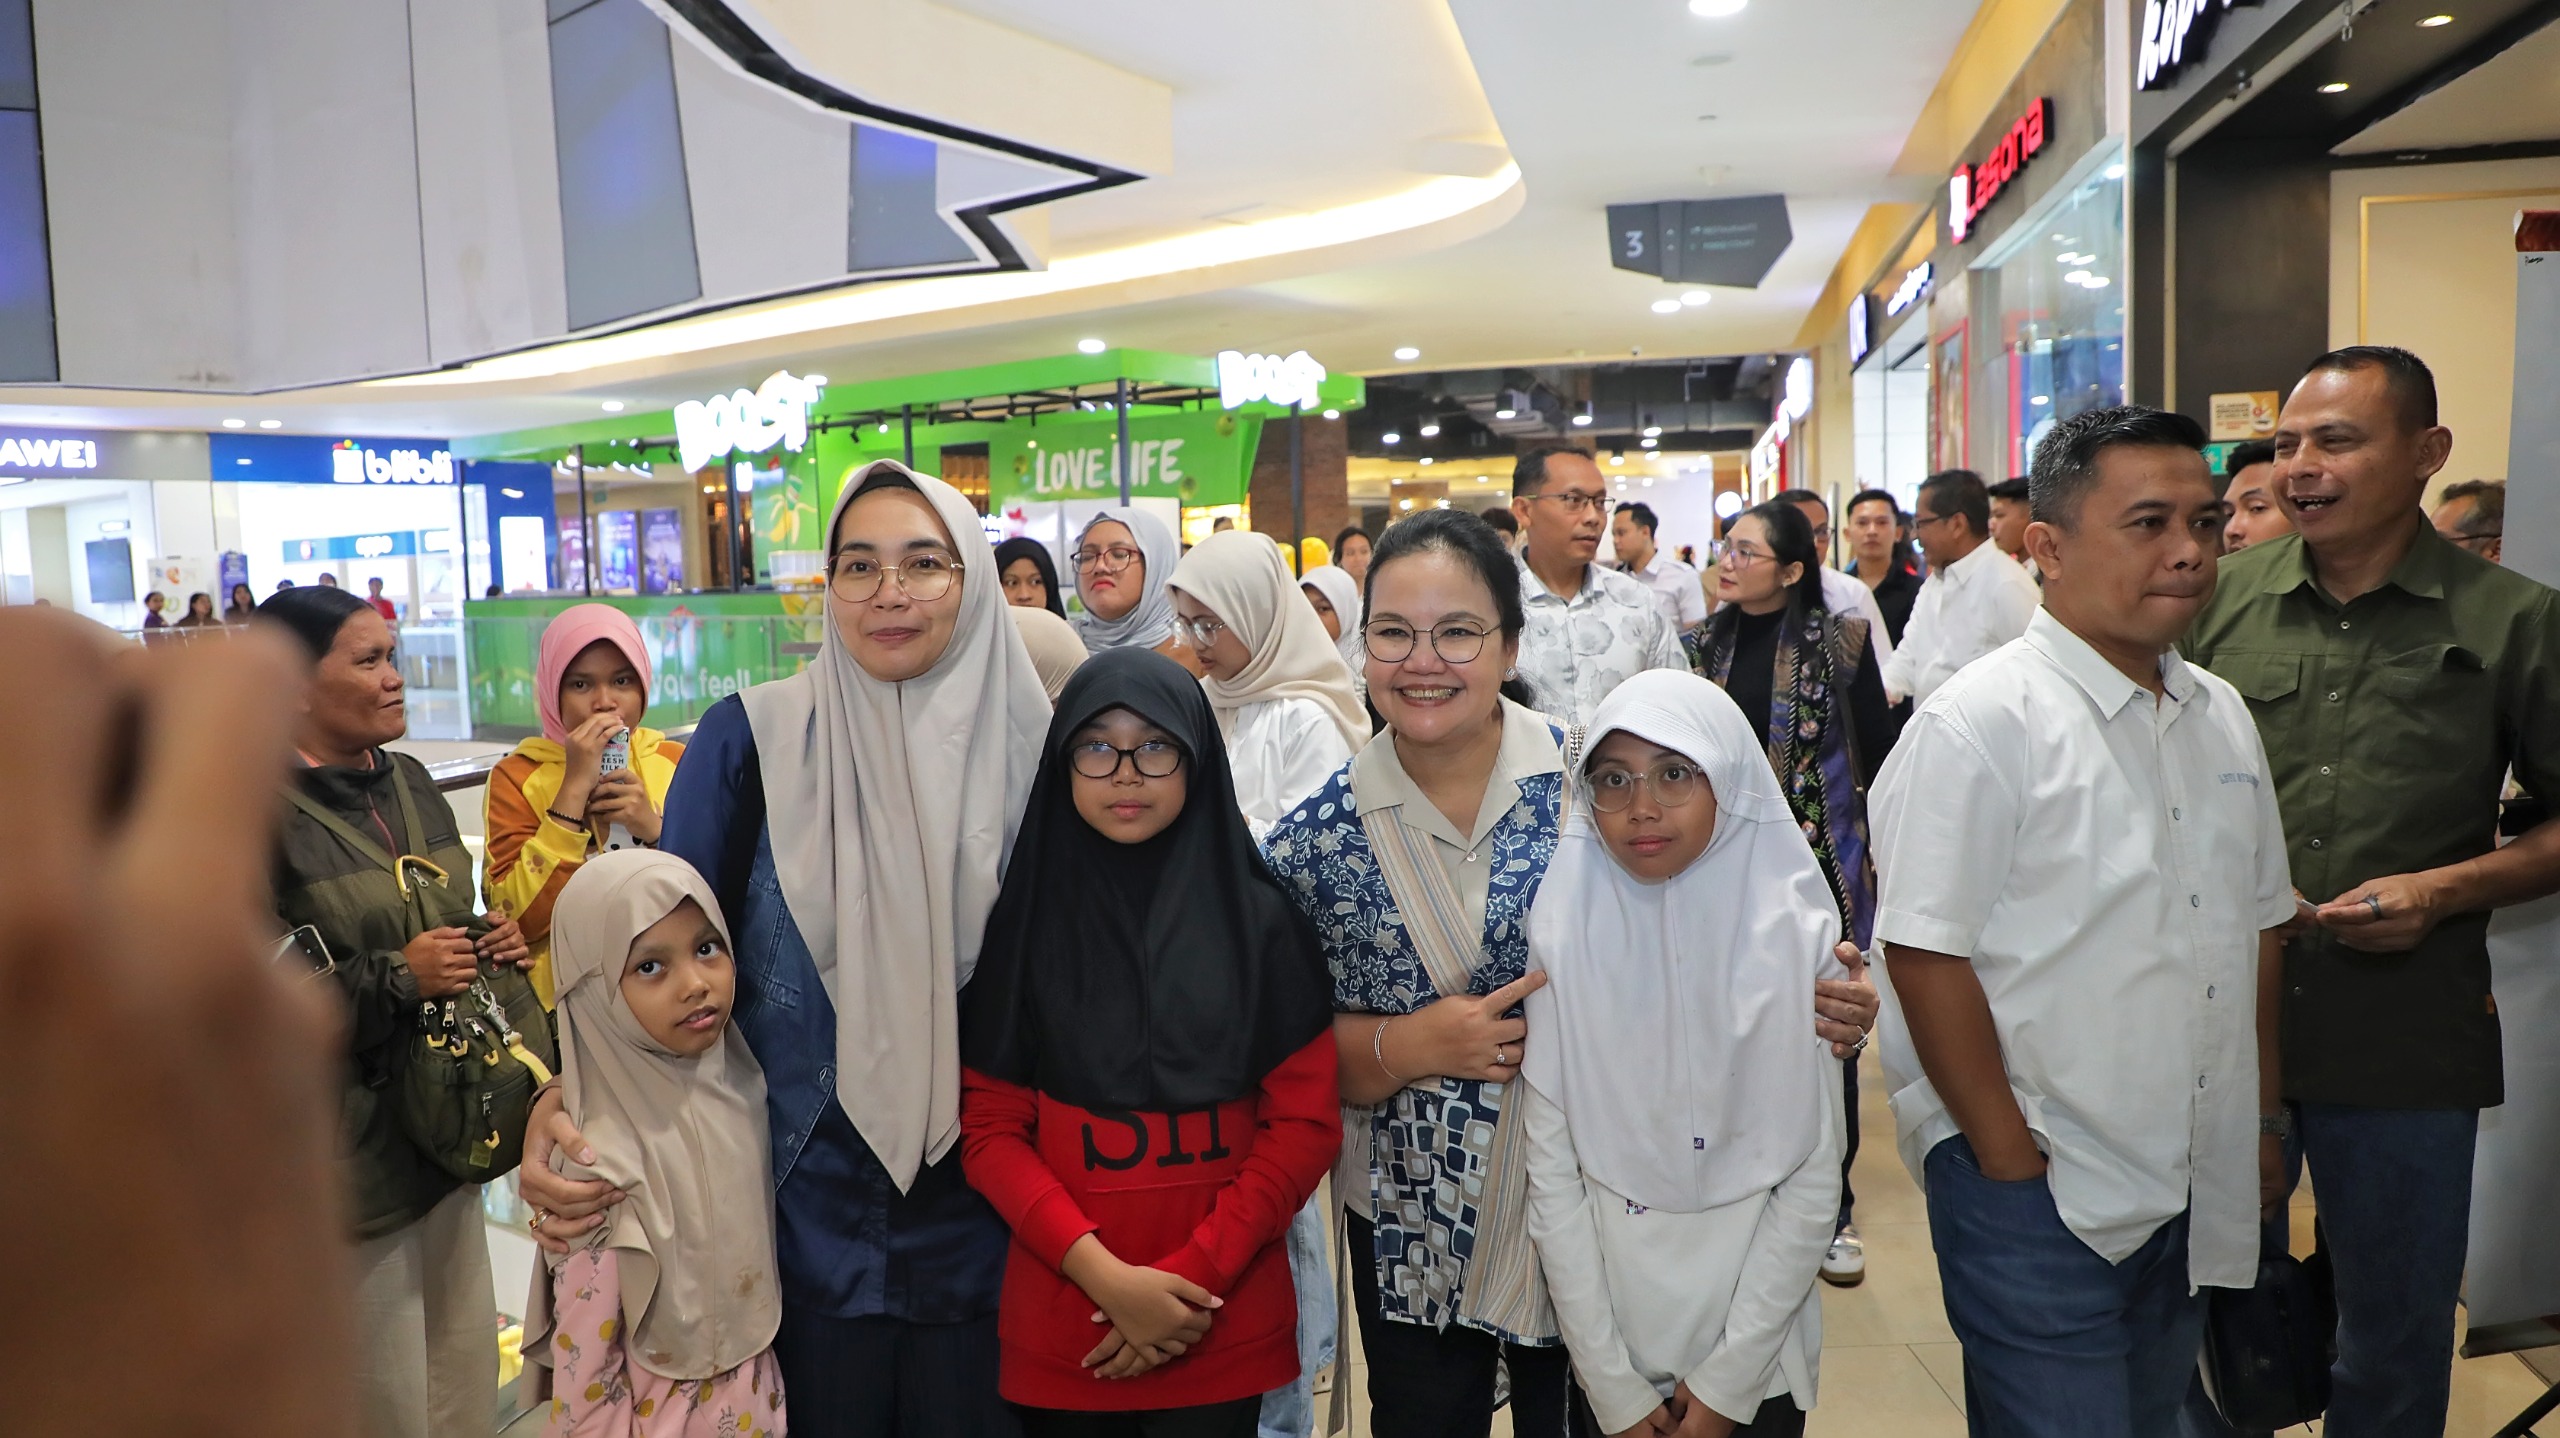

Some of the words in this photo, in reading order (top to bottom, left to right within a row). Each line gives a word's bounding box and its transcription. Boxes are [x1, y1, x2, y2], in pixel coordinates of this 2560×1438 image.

[2137, 0, 2207, 91] kop
[1625, 230, 1644, 258] 3
[365, 448, 453, 484] blibli
[1035, 448, 1105, 494] LOVE
[1110, 438, 1185, 487] LIFE
